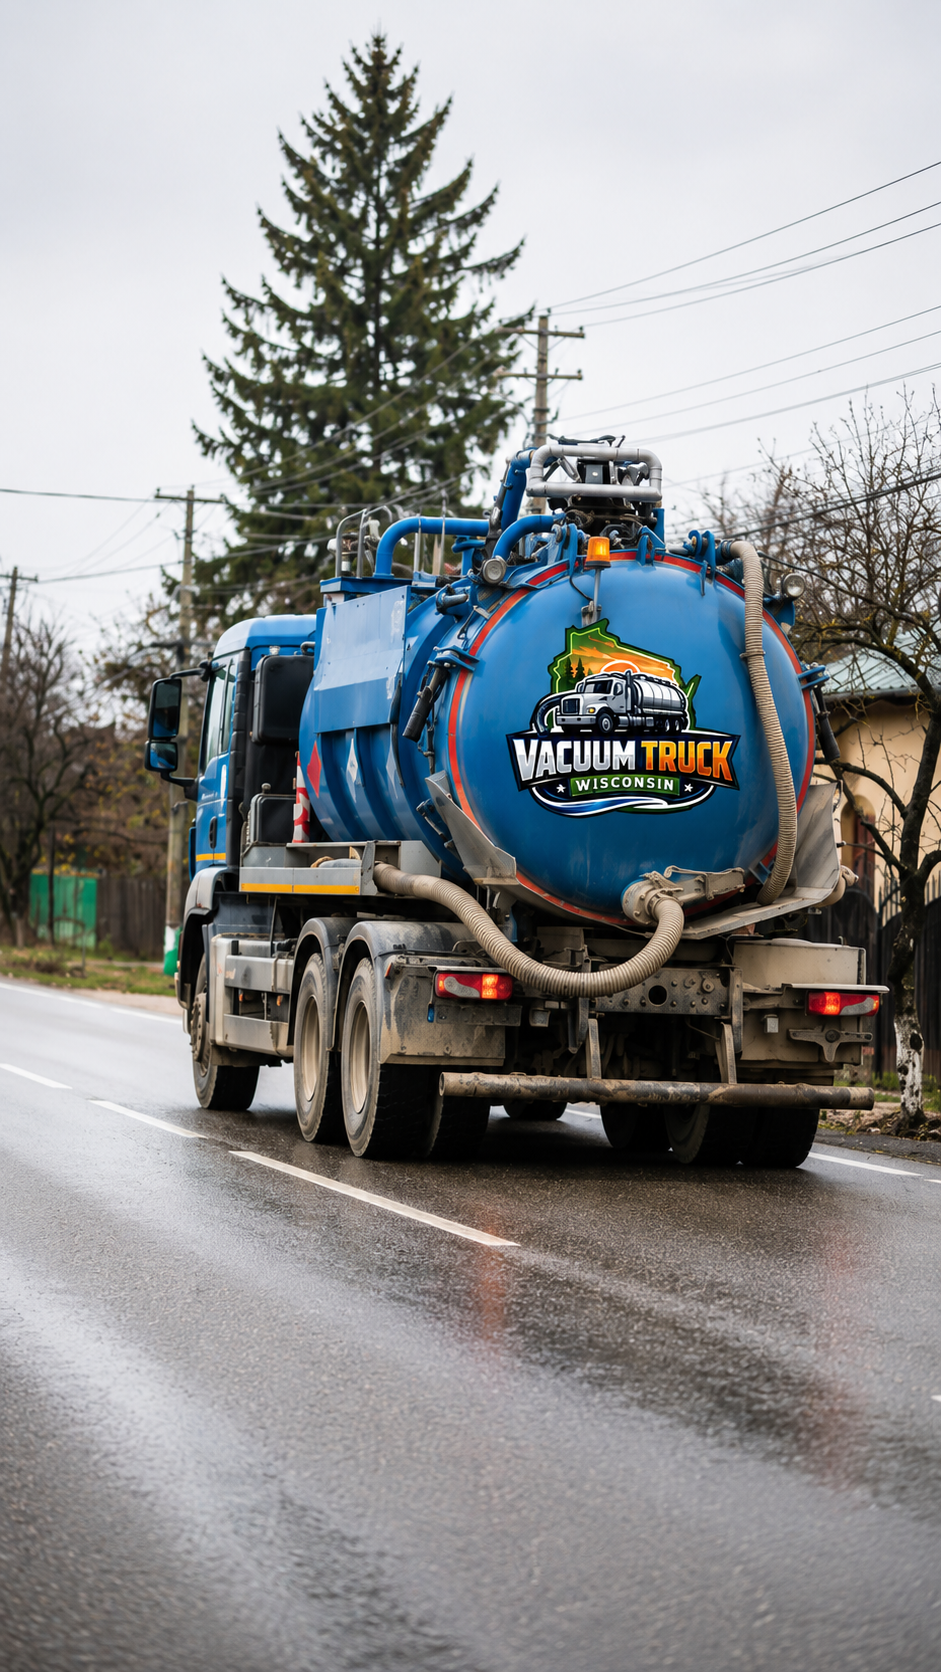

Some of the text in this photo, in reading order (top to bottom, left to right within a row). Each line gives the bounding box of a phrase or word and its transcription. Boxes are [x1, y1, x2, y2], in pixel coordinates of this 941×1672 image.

[513, 739, 733, 781] VACUUM TRUCK
[576, 776, 674, 791] WISCONSIN
